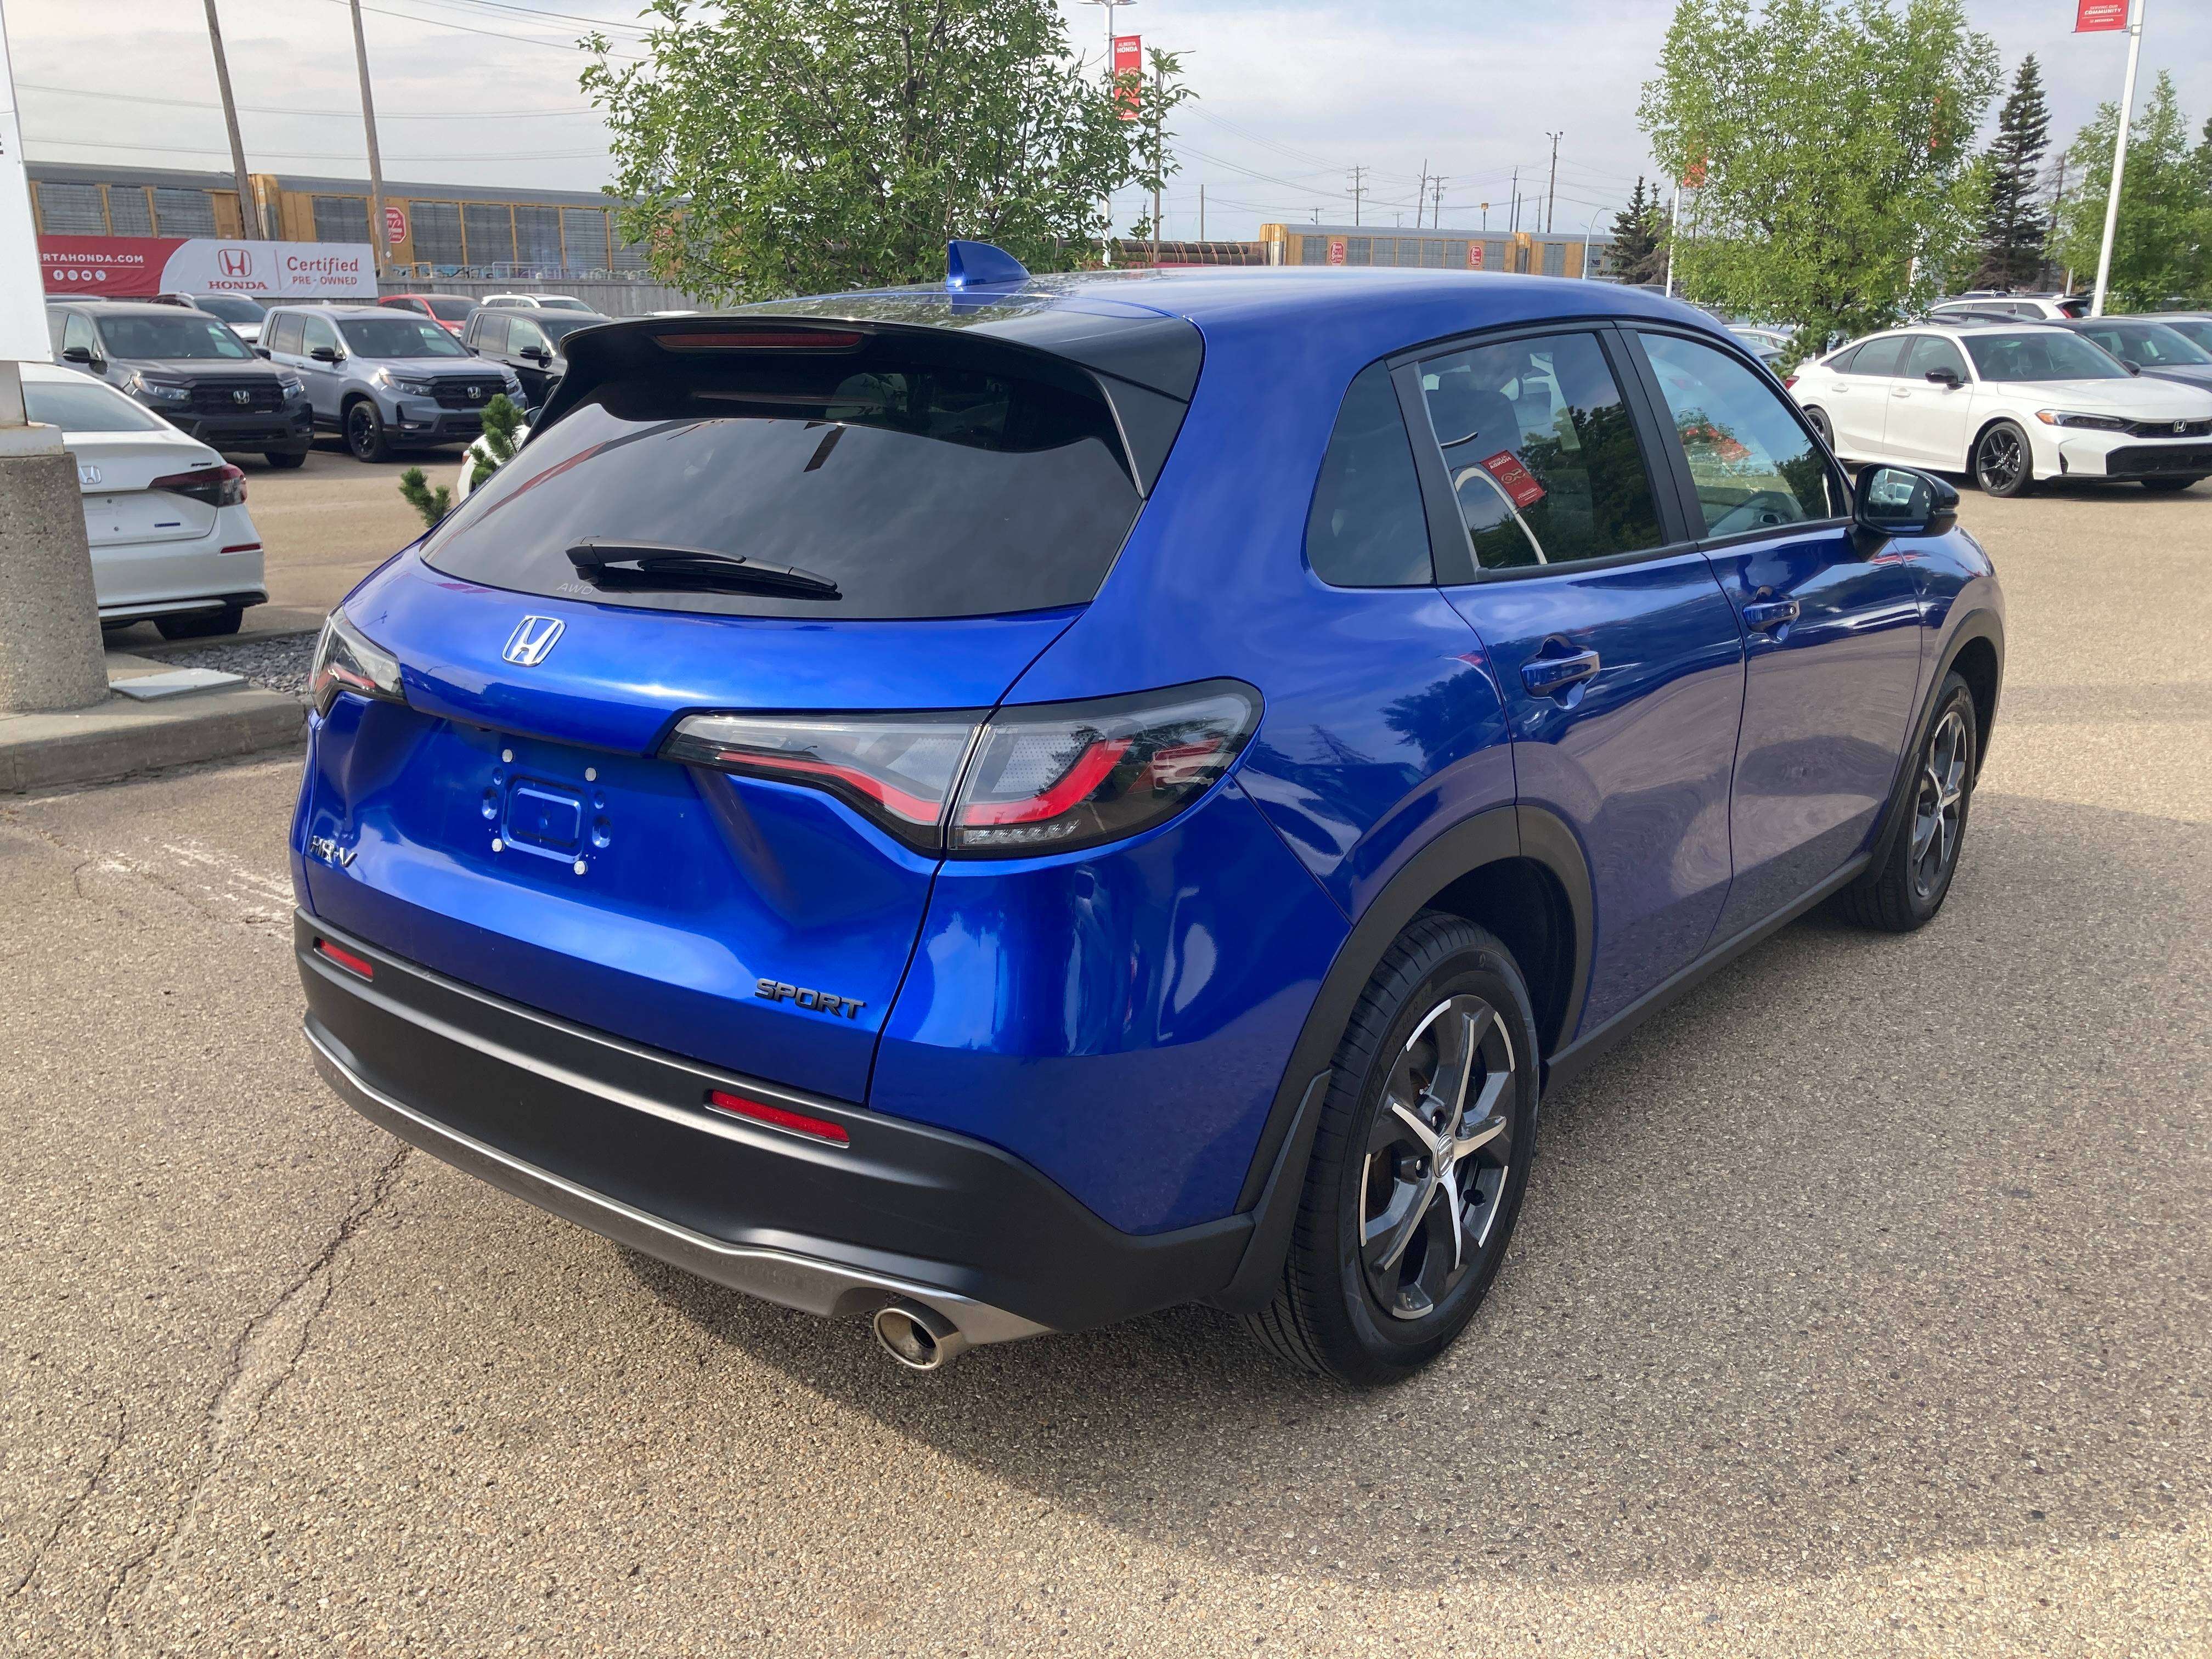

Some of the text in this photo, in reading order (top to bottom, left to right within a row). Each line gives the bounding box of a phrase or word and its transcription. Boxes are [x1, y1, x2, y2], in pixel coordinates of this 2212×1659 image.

[287, 256, 359, 275] Certified
[207, 280, 269, 290] HONDA
[556, 583, 594, 595] AWD
[310, 835, 358, 868] HR-V
[755, 978, 866, 1019] SPORT
